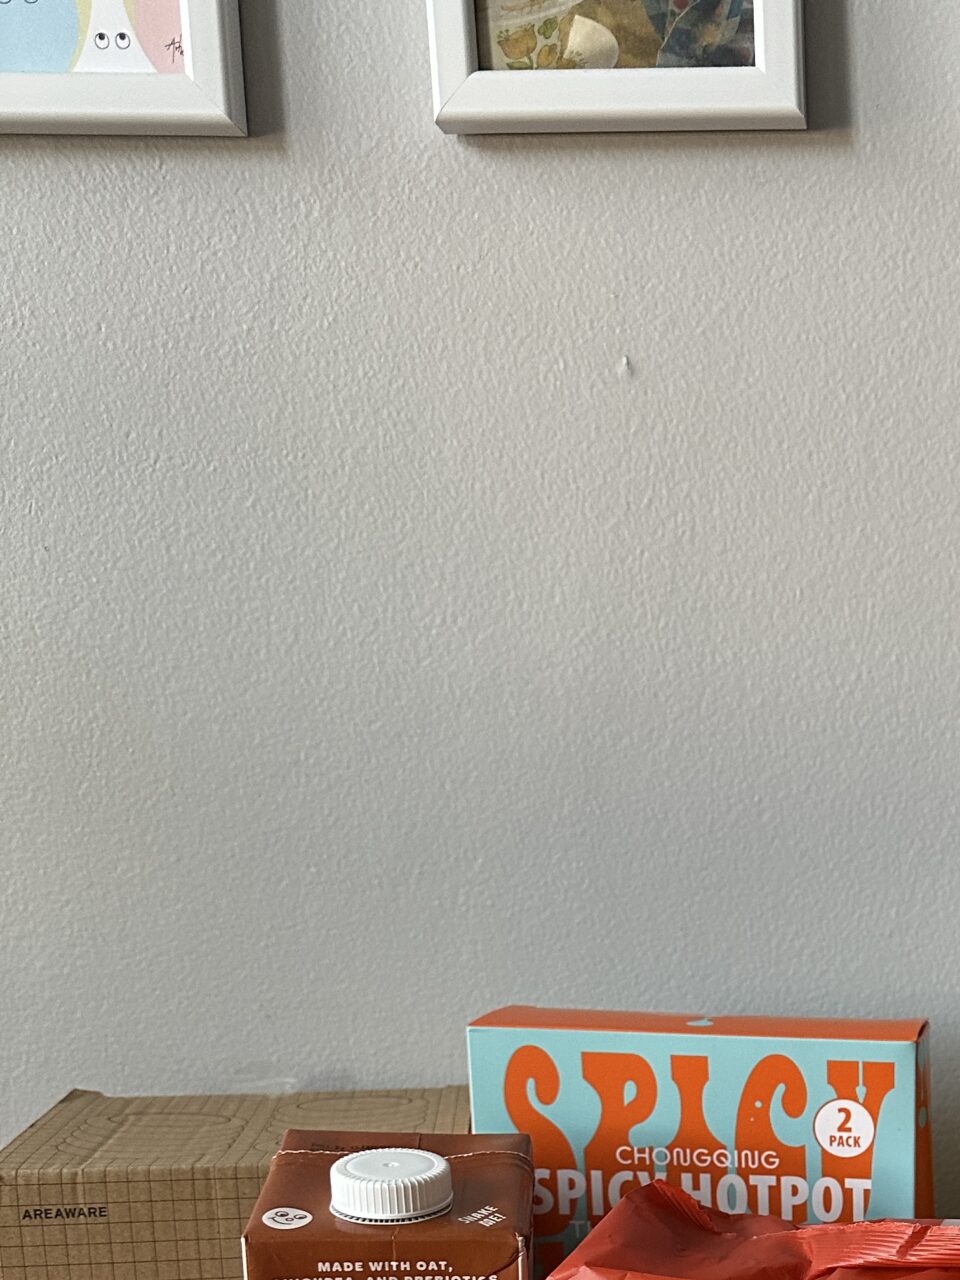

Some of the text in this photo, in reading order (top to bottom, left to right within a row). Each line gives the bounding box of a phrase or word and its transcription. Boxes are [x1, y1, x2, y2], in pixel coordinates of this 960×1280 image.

[837, 1108, 853, 1133] 2
[504, 1044, 895, 1236] SPICY
[829, 1135, 861, 1148] PACK
[616, 1146, 780, 1169] CHONGQING
[681, 1173, 871, 1221] HOTPOT
[22, 1206, 108, 1220] AREAWARE
[457, 1205, 498, 1224] SHAKE
[478, 1213, 507, 1227] ME!
[318, 1261, 453, 1272] MADE WITH OAT,
